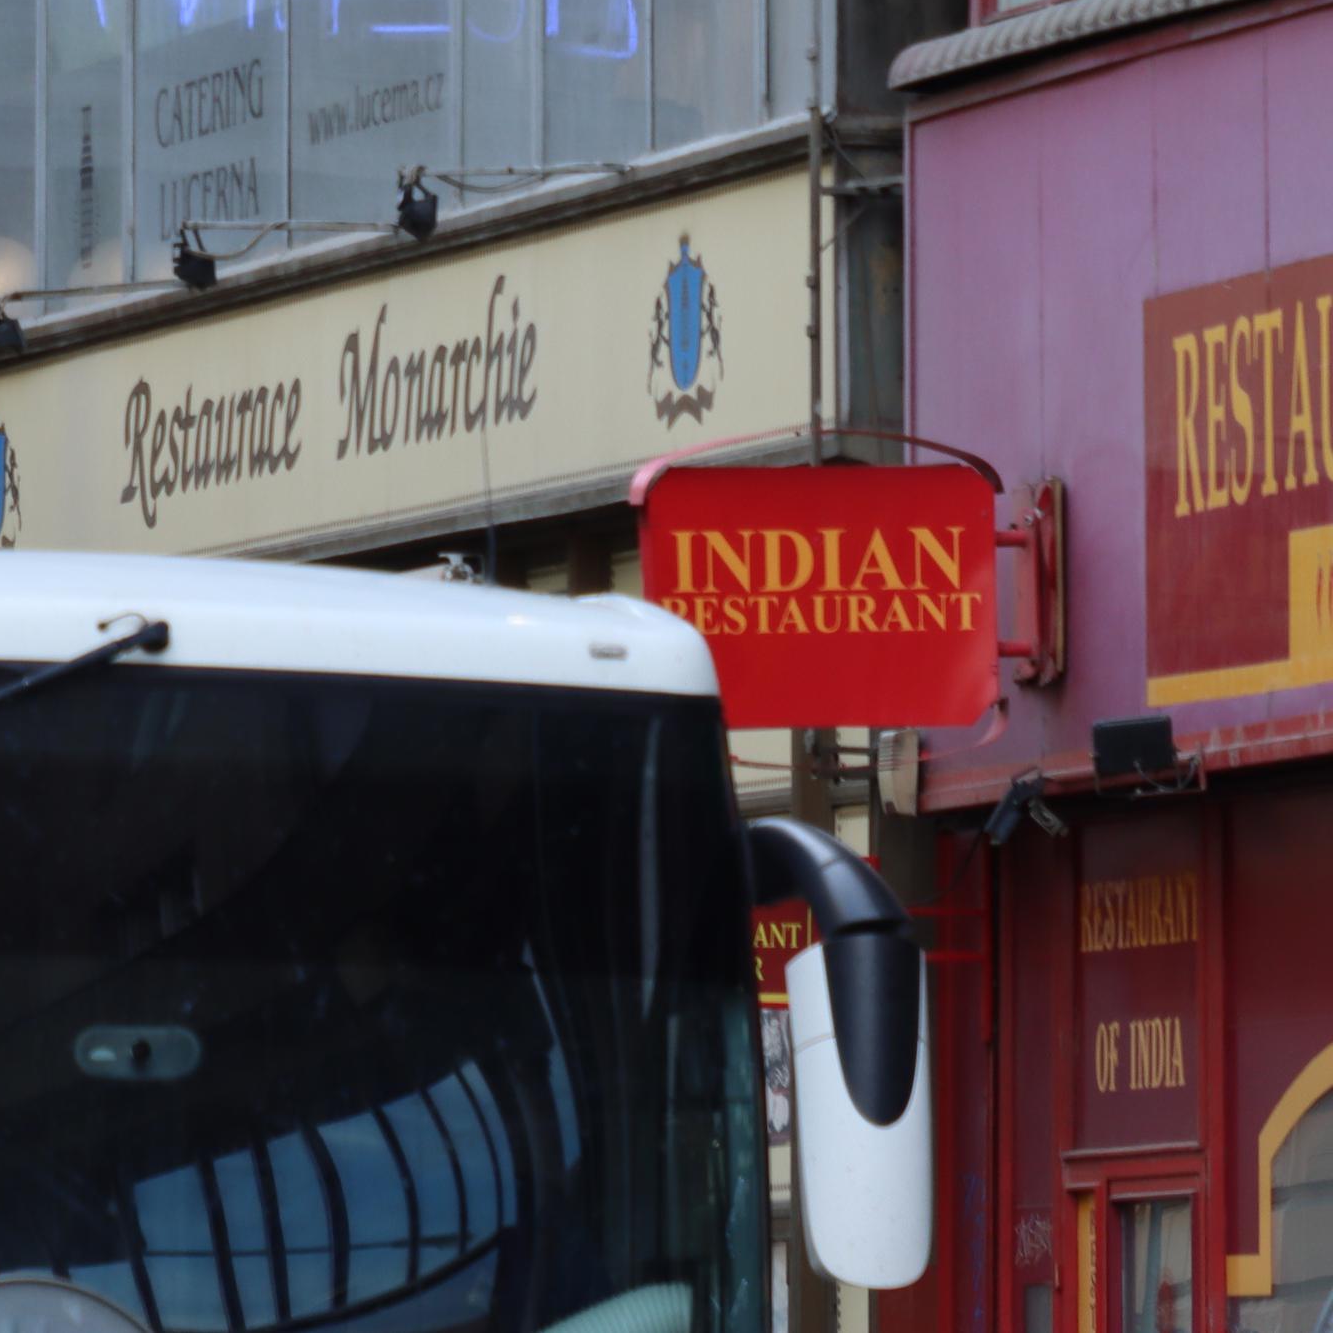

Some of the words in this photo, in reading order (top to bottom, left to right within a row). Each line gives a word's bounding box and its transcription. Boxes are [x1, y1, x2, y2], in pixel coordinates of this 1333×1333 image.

[154, 58, 264, 148] CATERING
[307, 72, 446, 146] www.lucerna.cz
[159, 155, 261, 242] LUCERNA
[120, 375, 303, 530] Restaurace
[336, 274, 538, 462] Monarchie
[671, 525, 966, 594] INDIAN
[660, 591, 982, 636] RESTAURANT
[1080, 873, 1199, 953] RESTAURANT
[1095, 1019, 1120, 1094] OF
[1129, 1016, 1186, 1091] INDIA
